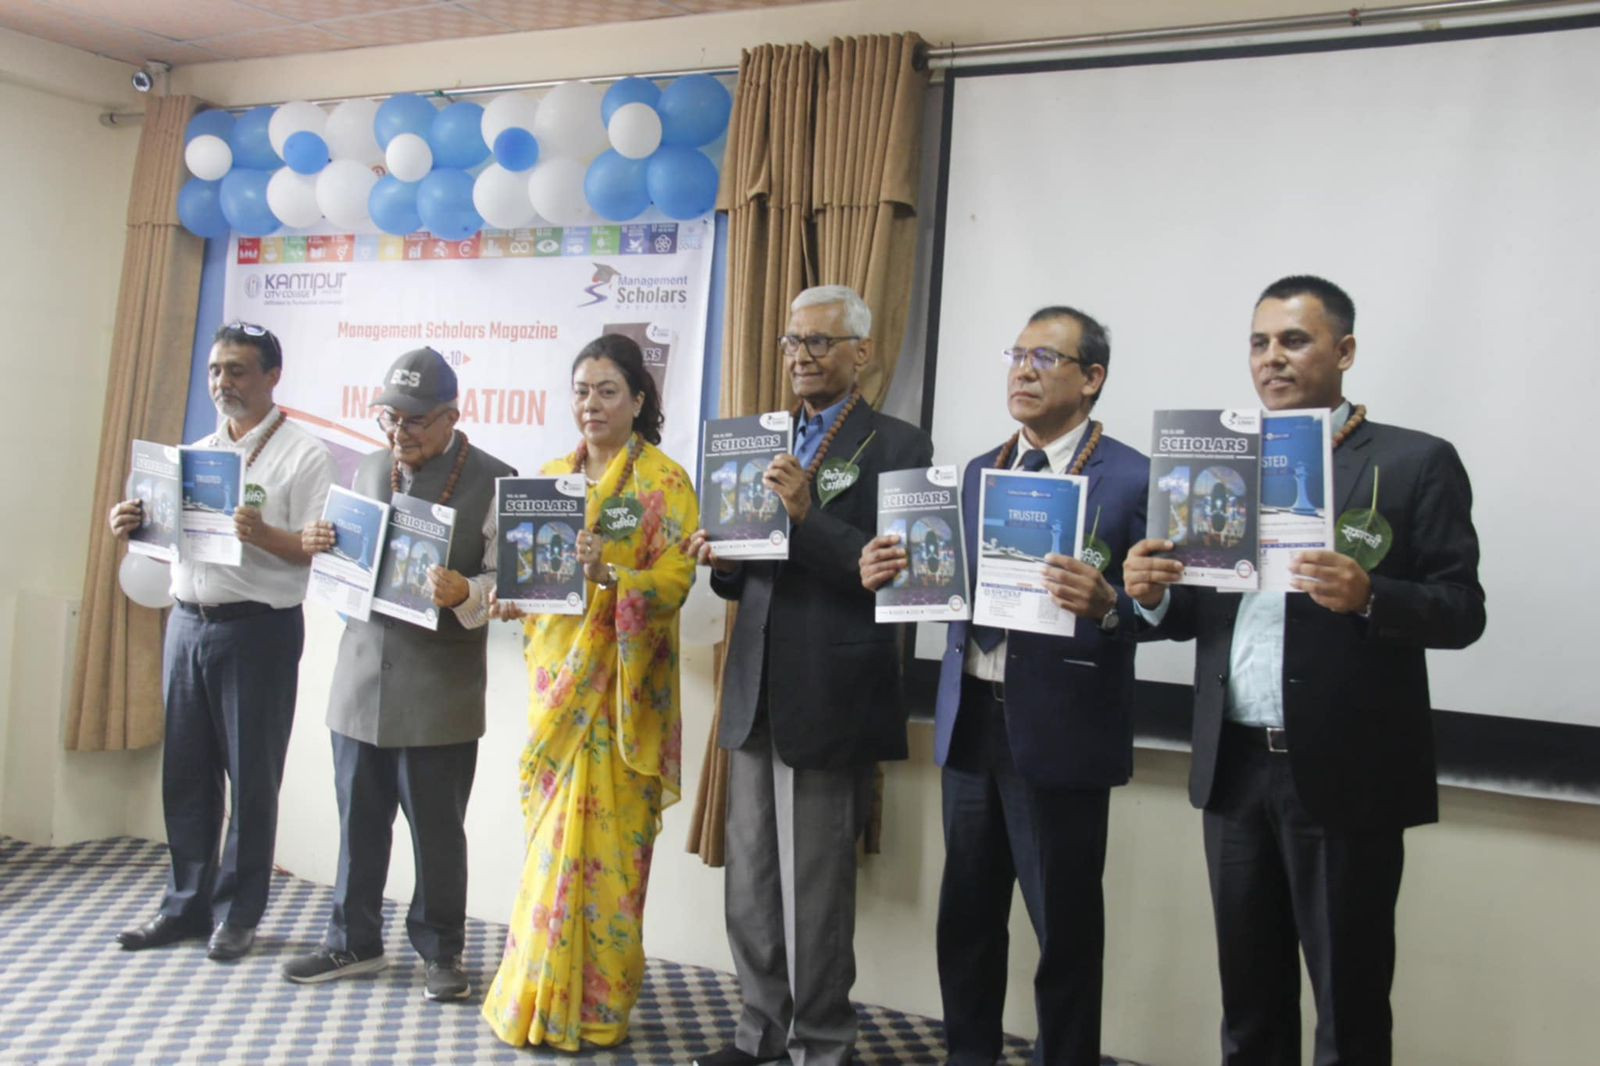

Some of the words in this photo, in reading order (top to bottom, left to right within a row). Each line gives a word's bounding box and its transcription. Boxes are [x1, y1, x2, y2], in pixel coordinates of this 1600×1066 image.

[618, 276, 687, 288] Management
[617, 286, 687, 303] Scholars
[337, 321, 422, 341] Management
[425, 320, 485, 339] Scholars
[489, 320, 558, 342] Magazine
[711, 434, 781, 452] SCHOLARS
[1159, 436, 1248, 453] SCHOLARS
[506, 499, 578, 512] SCHOLARS
[882, 490, 951, 508] SCHOLARS
[393, 511, 447, 537] SCHOLARS
[1008, 509, 1048, 522] TRUSTED
